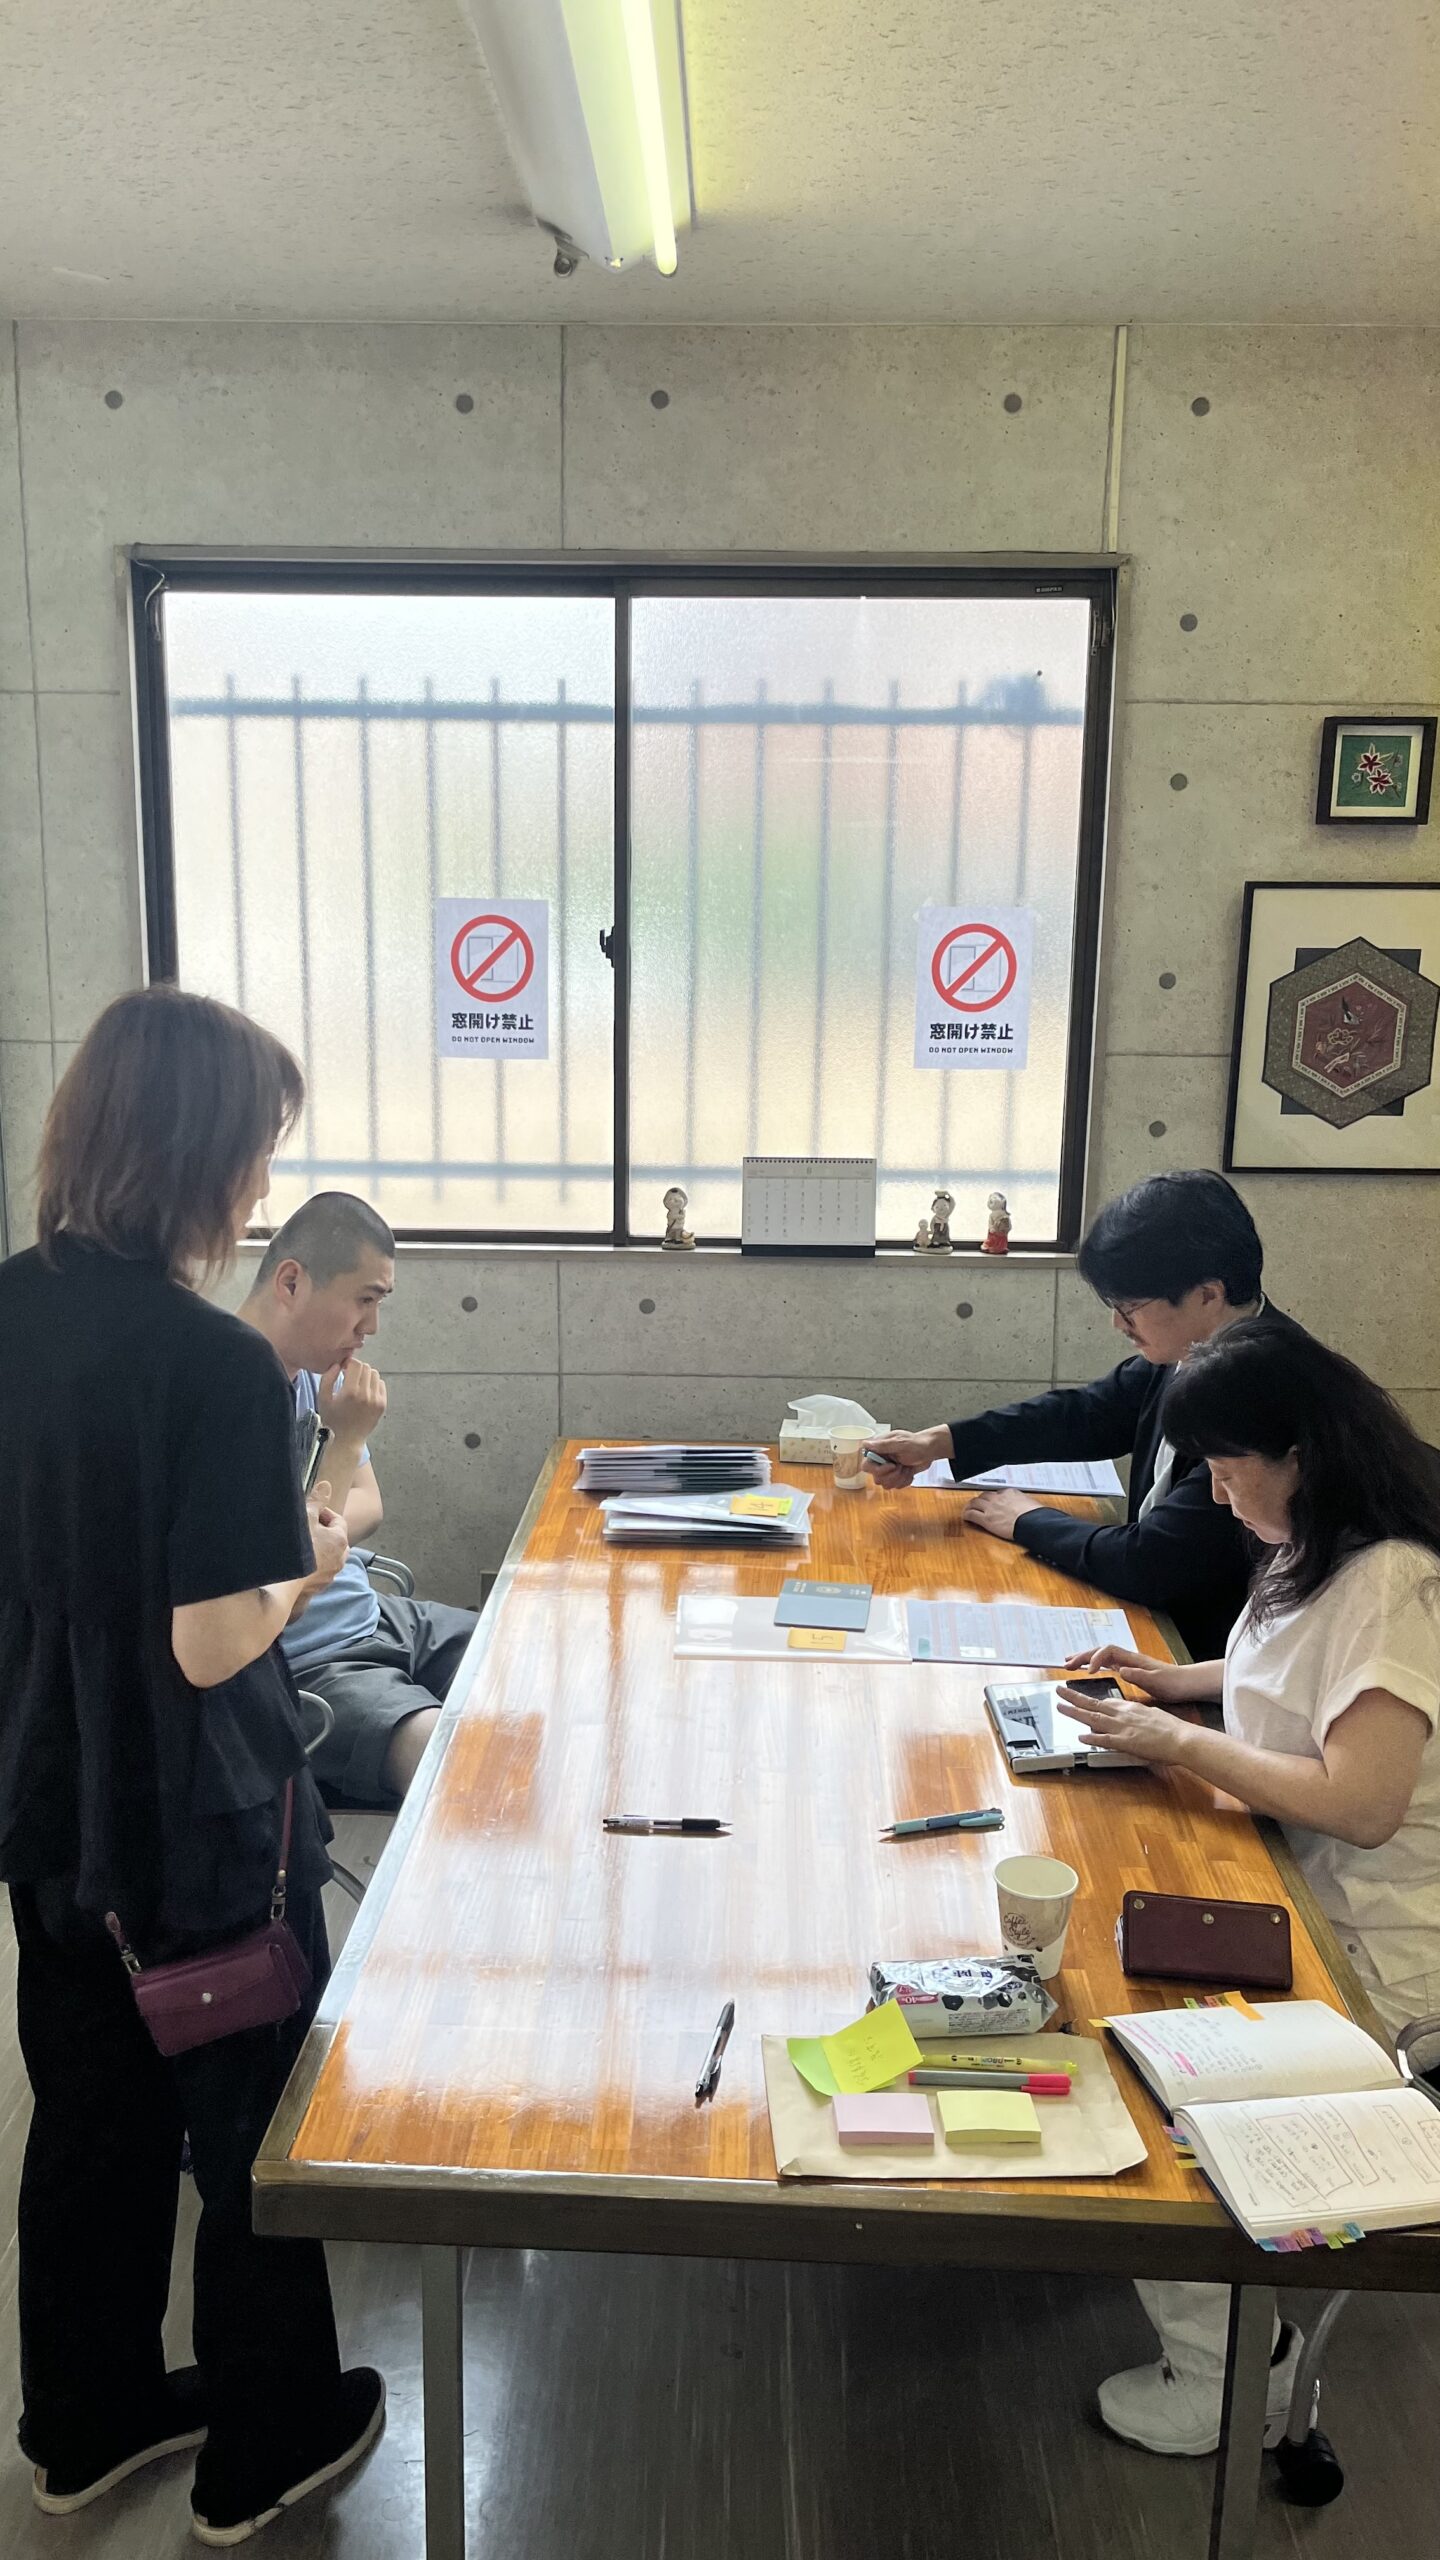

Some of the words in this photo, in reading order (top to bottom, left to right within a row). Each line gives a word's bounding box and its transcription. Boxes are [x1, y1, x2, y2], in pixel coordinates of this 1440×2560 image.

[452, 1012, 534, 1030] 窓開け禁止
[930, 1022, 1013, 1040] 窓開け禁止
